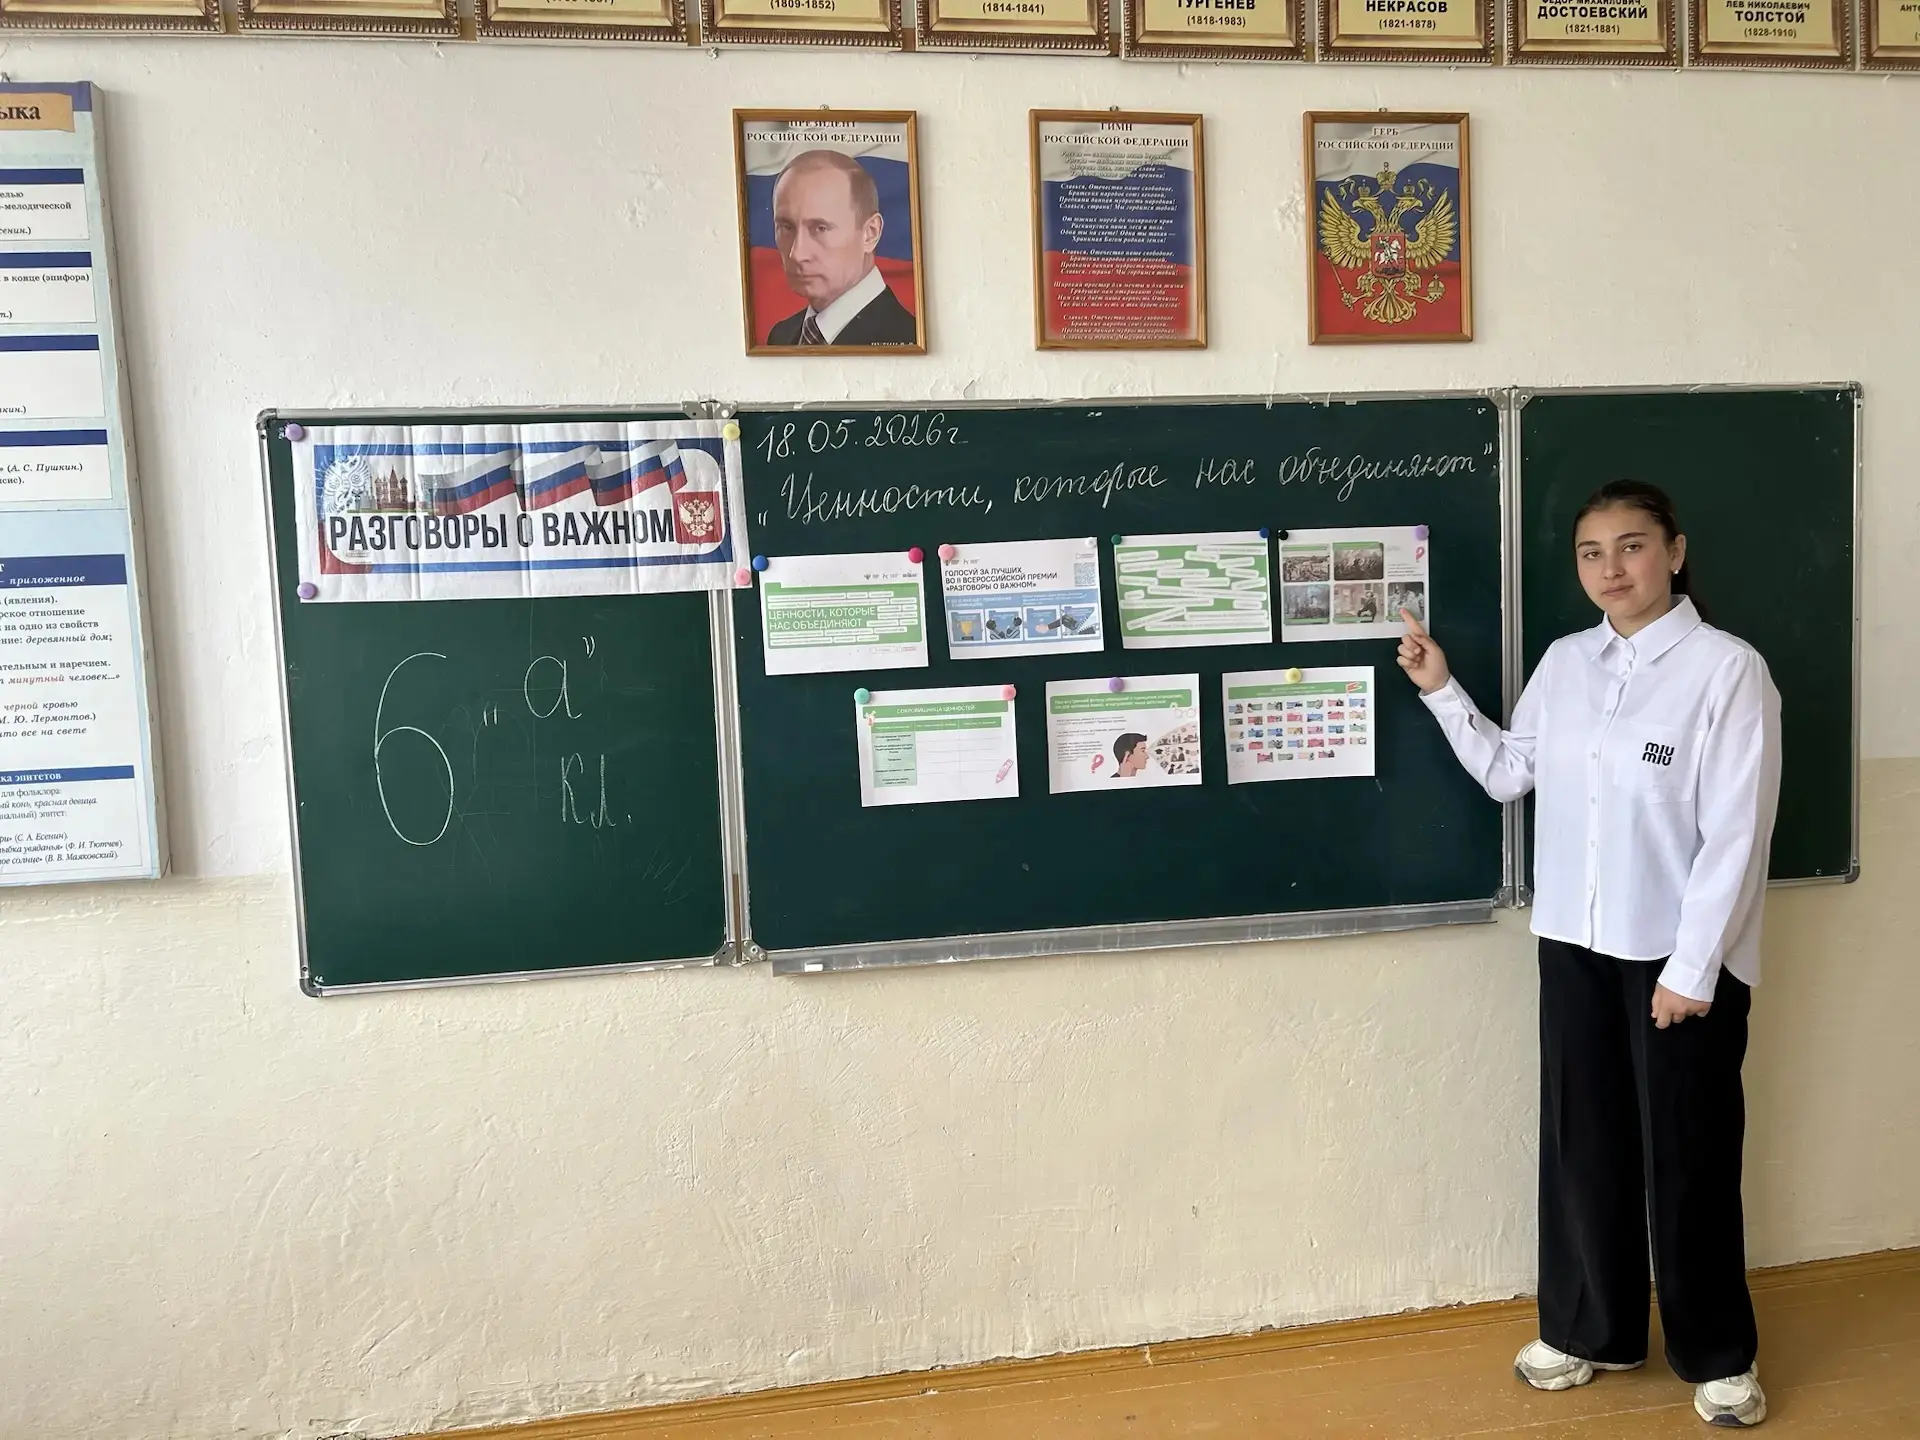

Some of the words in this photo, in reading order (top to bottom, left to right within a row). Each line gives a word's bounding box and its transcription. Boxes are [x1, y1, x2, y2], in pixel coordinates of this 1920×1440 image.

[982, 3, 1045, 15] (1814-1841)
[1177, 0, 1256, 10] ТУРГЕНЕВ
[1365, 0, 1448, 13] НЕКРАСОВ
[1726, 0, 1745, 8] ЛЕВ
[1747, 1, 1810, 10] НИКОЛАЕВИЧ
[1537, 5, 1648, 19] ДОСТОЕВСКИЙ
[1734, 10, 1805, 23] ТОЛСТОЙ
[1187, 15, 1246, 27] (1818-1983)
[1378, 18, 1436, 30] (1821-1878)
[1565, 24, 1620, 35] (1821-1881)
[1744, 28, 1797, 38] (1828-1910)
[1100, 122, 1133, 132] ГИМН
[1373, 127, 1399, 136] ГЕРБ
[746, 131, 828, 142] РОССИЙСКОЙ
[830, 132, 901, 144] ФЕДЕРАЦИИ
[1044, 133, 1121, 145] РОССИЙСКОЙ
[1123, 136, 1189, 148] ФЕДЕРАЦИИ
[1317, 138, 1389, 149] РОССИЙСКОЙ
[1391, 140, 1454, 151] ФЕДЕРАЦИИ
[42, 273, 90, 283] (эпифора)
[36, 462, 83, 473] Пушкин.)
[1013, 461, 1168, 509] которые
[1195, 456, 1256, 490] нас
[329, 512, 508, 551] РАЗГОВОРЫ
[517, 511, 534, 548] О
[543, 508, 674, 547] ВАЖНОМ
[944, 568, 979, 577] ГОЛОСУЙ
[980, 567, 990, 575] ЗА
[990, 566, 1022, 575] ЛУЧШИХ
[962, 573, 1026, 584] ВСЕРОССИЙСКОЙ
[1027, 571, 1058, 580] ПРЕМИИ
[9, 575, 86, 587] приложенное
[946, 583, 992, 592] «РАЗГОВОРЫ
[999, 580, 1037, 590] ВАЖНОМ»
[4, 595, 58, 606] (явления).
[29, 608, 85, 617] отношение
[768, 607, 829, 620] ЦЕННОСТИ,
[829, 605, 877, 617] КОТОРЫЕ
[19, 623, 43, 631] одно
[46, 622, 57, 630] из
[59, 620, 99, 629] свойств
[769, 620, 791, 631] НАС
[793, 617, 862, 630] ОБЪЕДИНЯЮТ
[25, 634, 86, 646] деревянный
[89, 632, 113, 643] дом;
[59, 659, 111, 670] наречием.
[8, 673, 65, 686] минутный
[42, 700, 78, 711] кровью
[31, 712, 96, 724] Лермонтов.)
[21, 729, 37, 737] все
[56, 727, 87, 736] свете
[374, 651, 454, 846] 6
[14, 772, 62, 782] эпитетов
